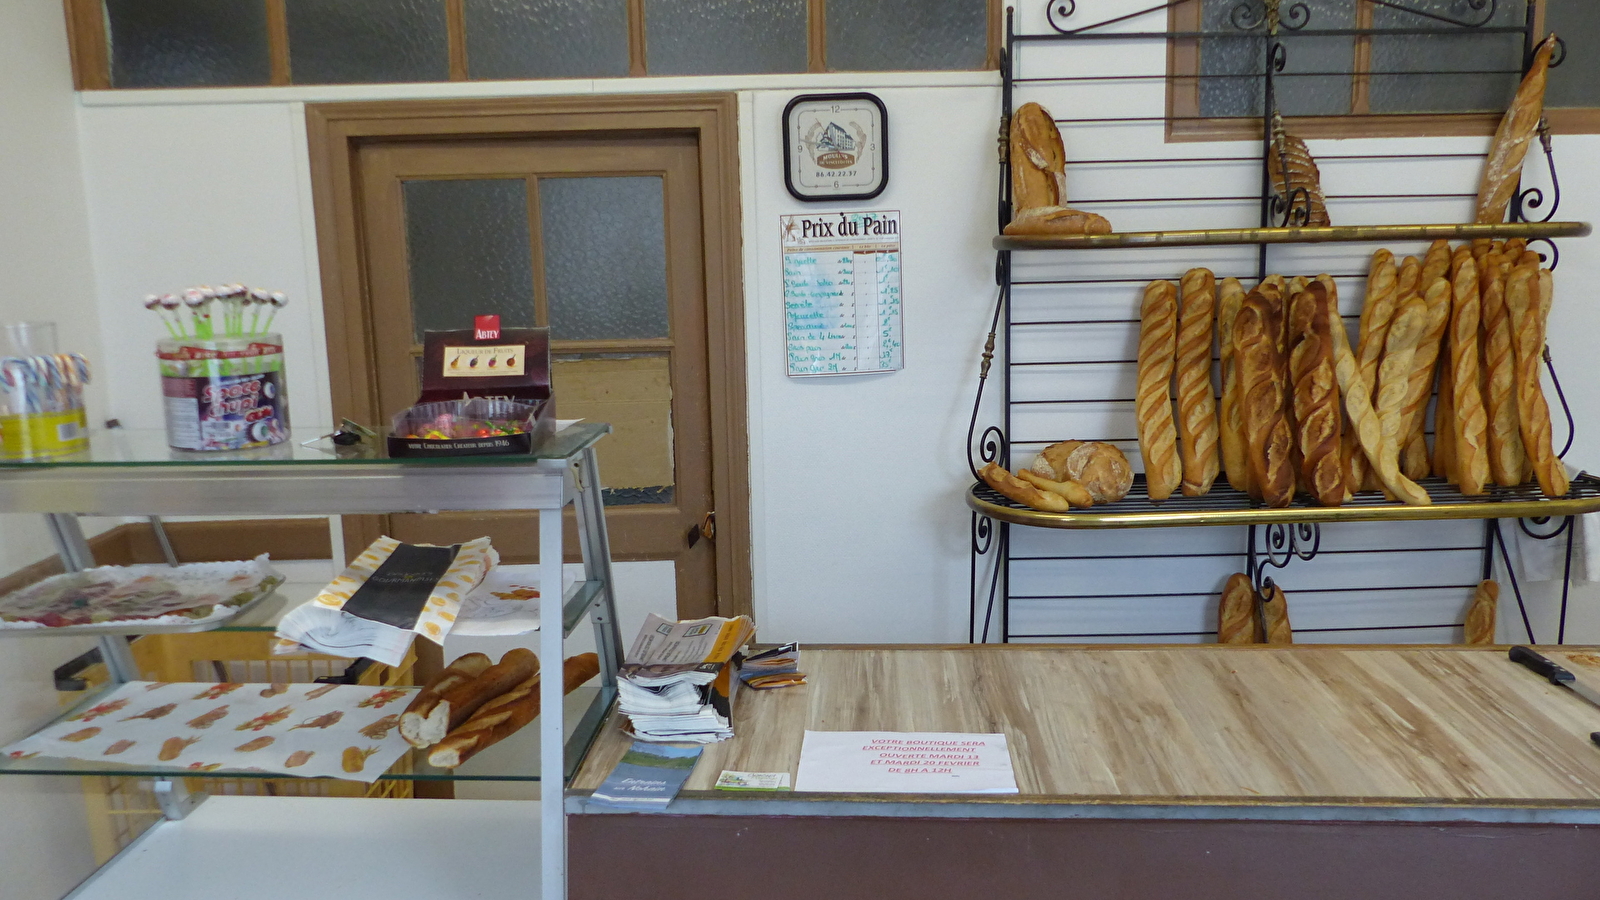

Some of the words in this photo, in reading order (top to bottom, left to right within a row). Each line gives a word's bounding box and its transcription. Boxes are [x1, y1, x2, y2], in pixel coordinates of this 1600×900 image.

[830, 105, 841, 114] 12
[797, 144, 803, 153] 9
[870, 143, 876, 151] 3
[833, 180, 840, 189] 6
[801, 217, 835, 239] Prix
[837, 215, 859, 237] du
[862, 214, 899, 236] Pain
[475, 329, 500, 340] ABTEY
[494, 439, 510, 447] 1946
[862, 745, 976, 753] EXCEPTIONNELLEMENT
